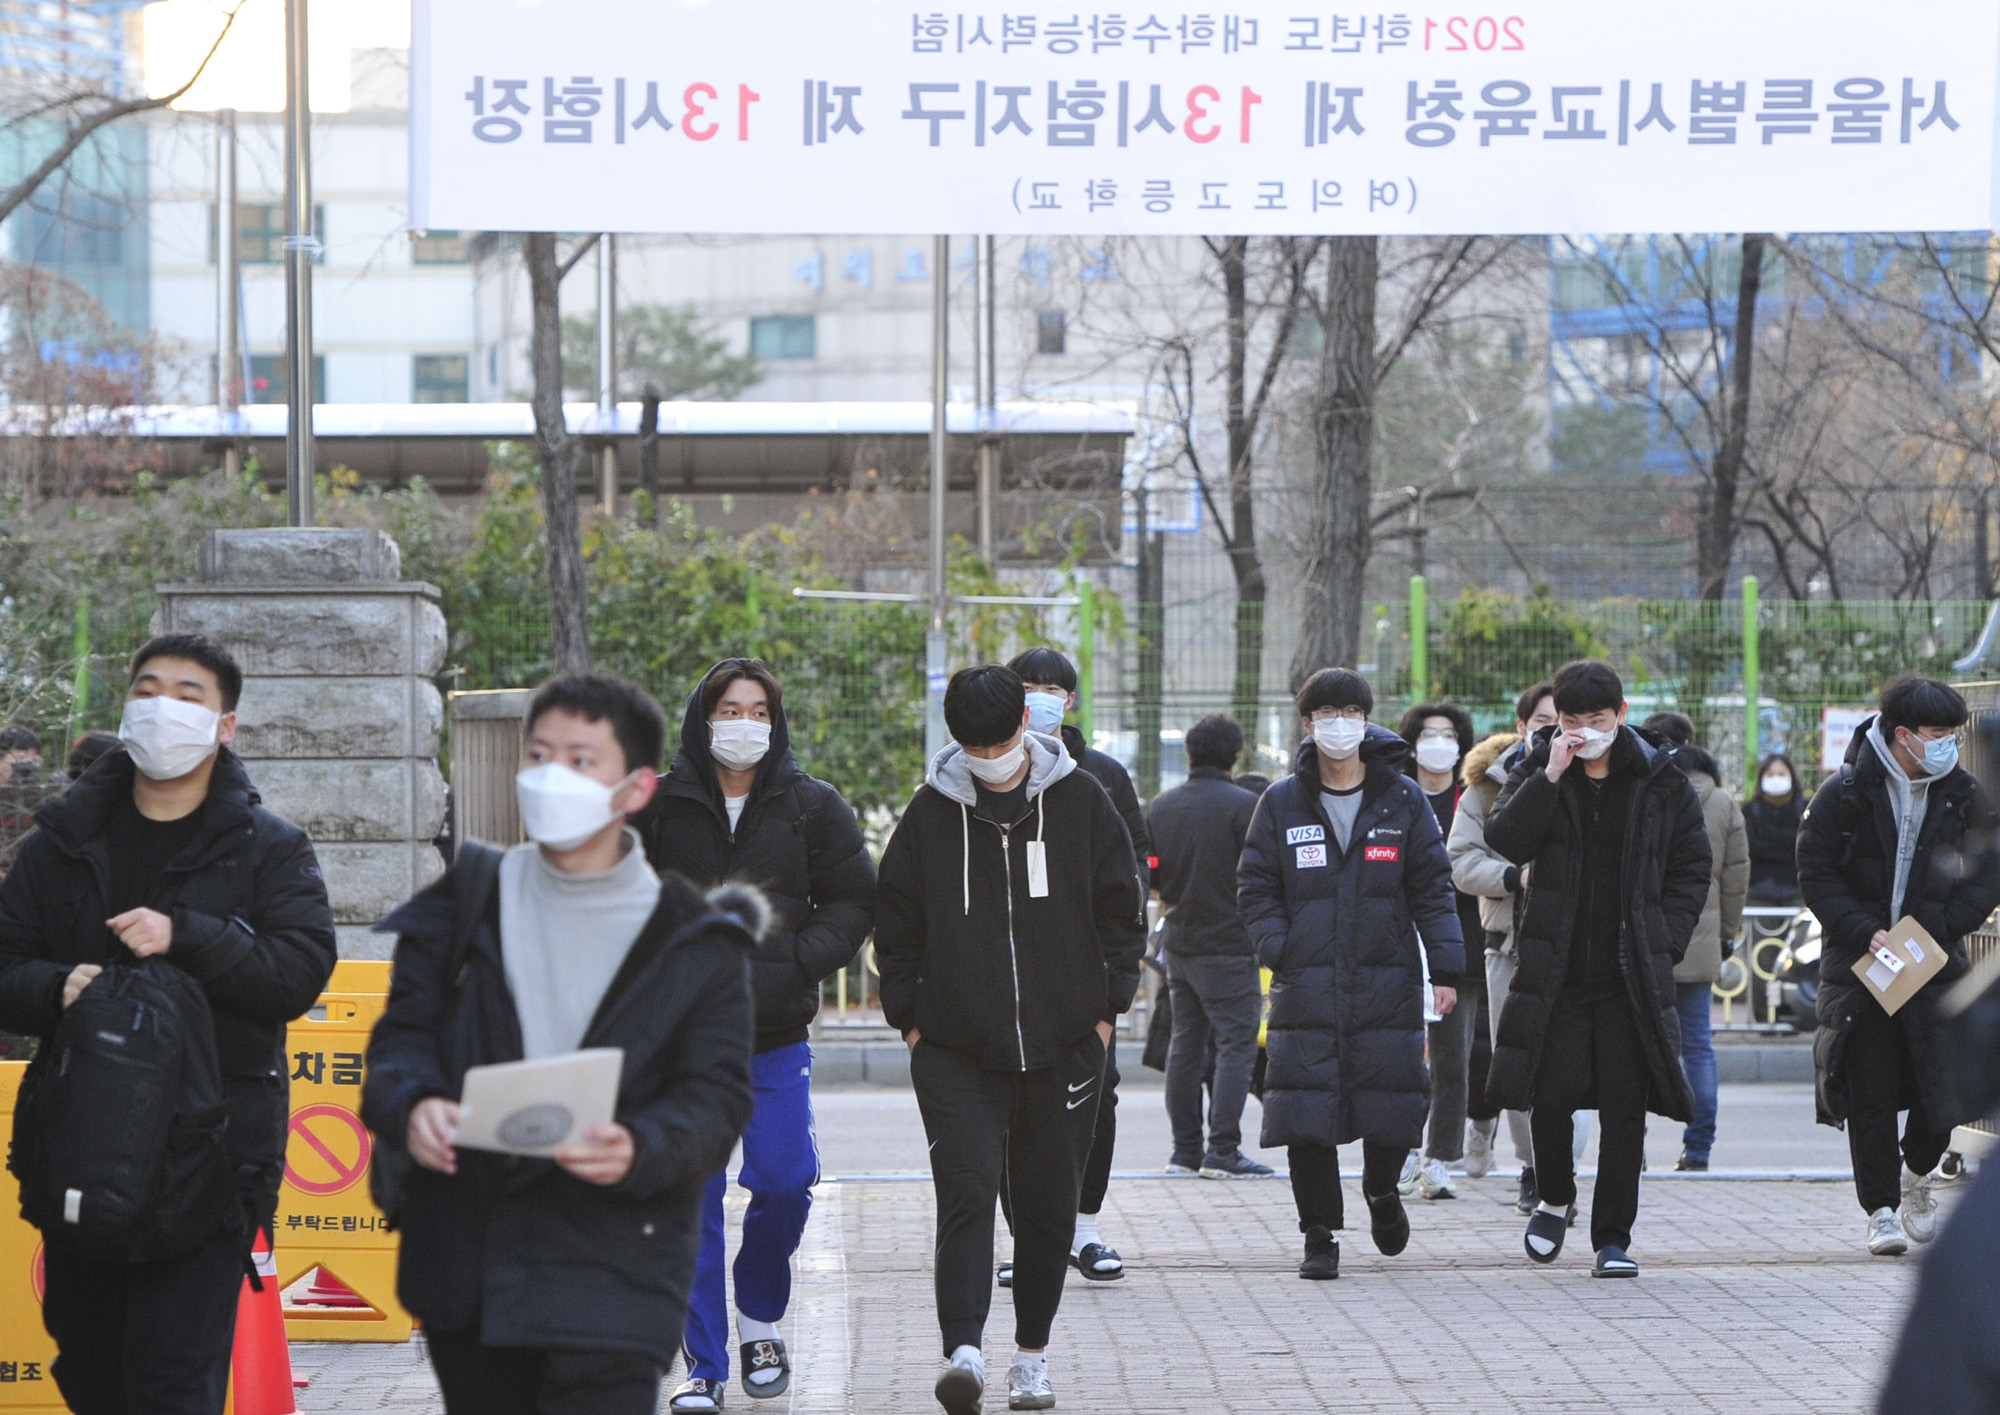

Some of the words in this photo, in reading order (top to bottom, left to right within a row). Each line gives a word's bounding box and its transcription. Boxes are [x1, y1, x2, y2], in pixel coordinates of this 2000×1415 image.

[1290, 827, 1323, 842] VISA
[1367, 848, 1396, 860] xfinity
[1298, 859, 1325, 867] TOYOTA
[291, 1051, 363, 1085] 차금
